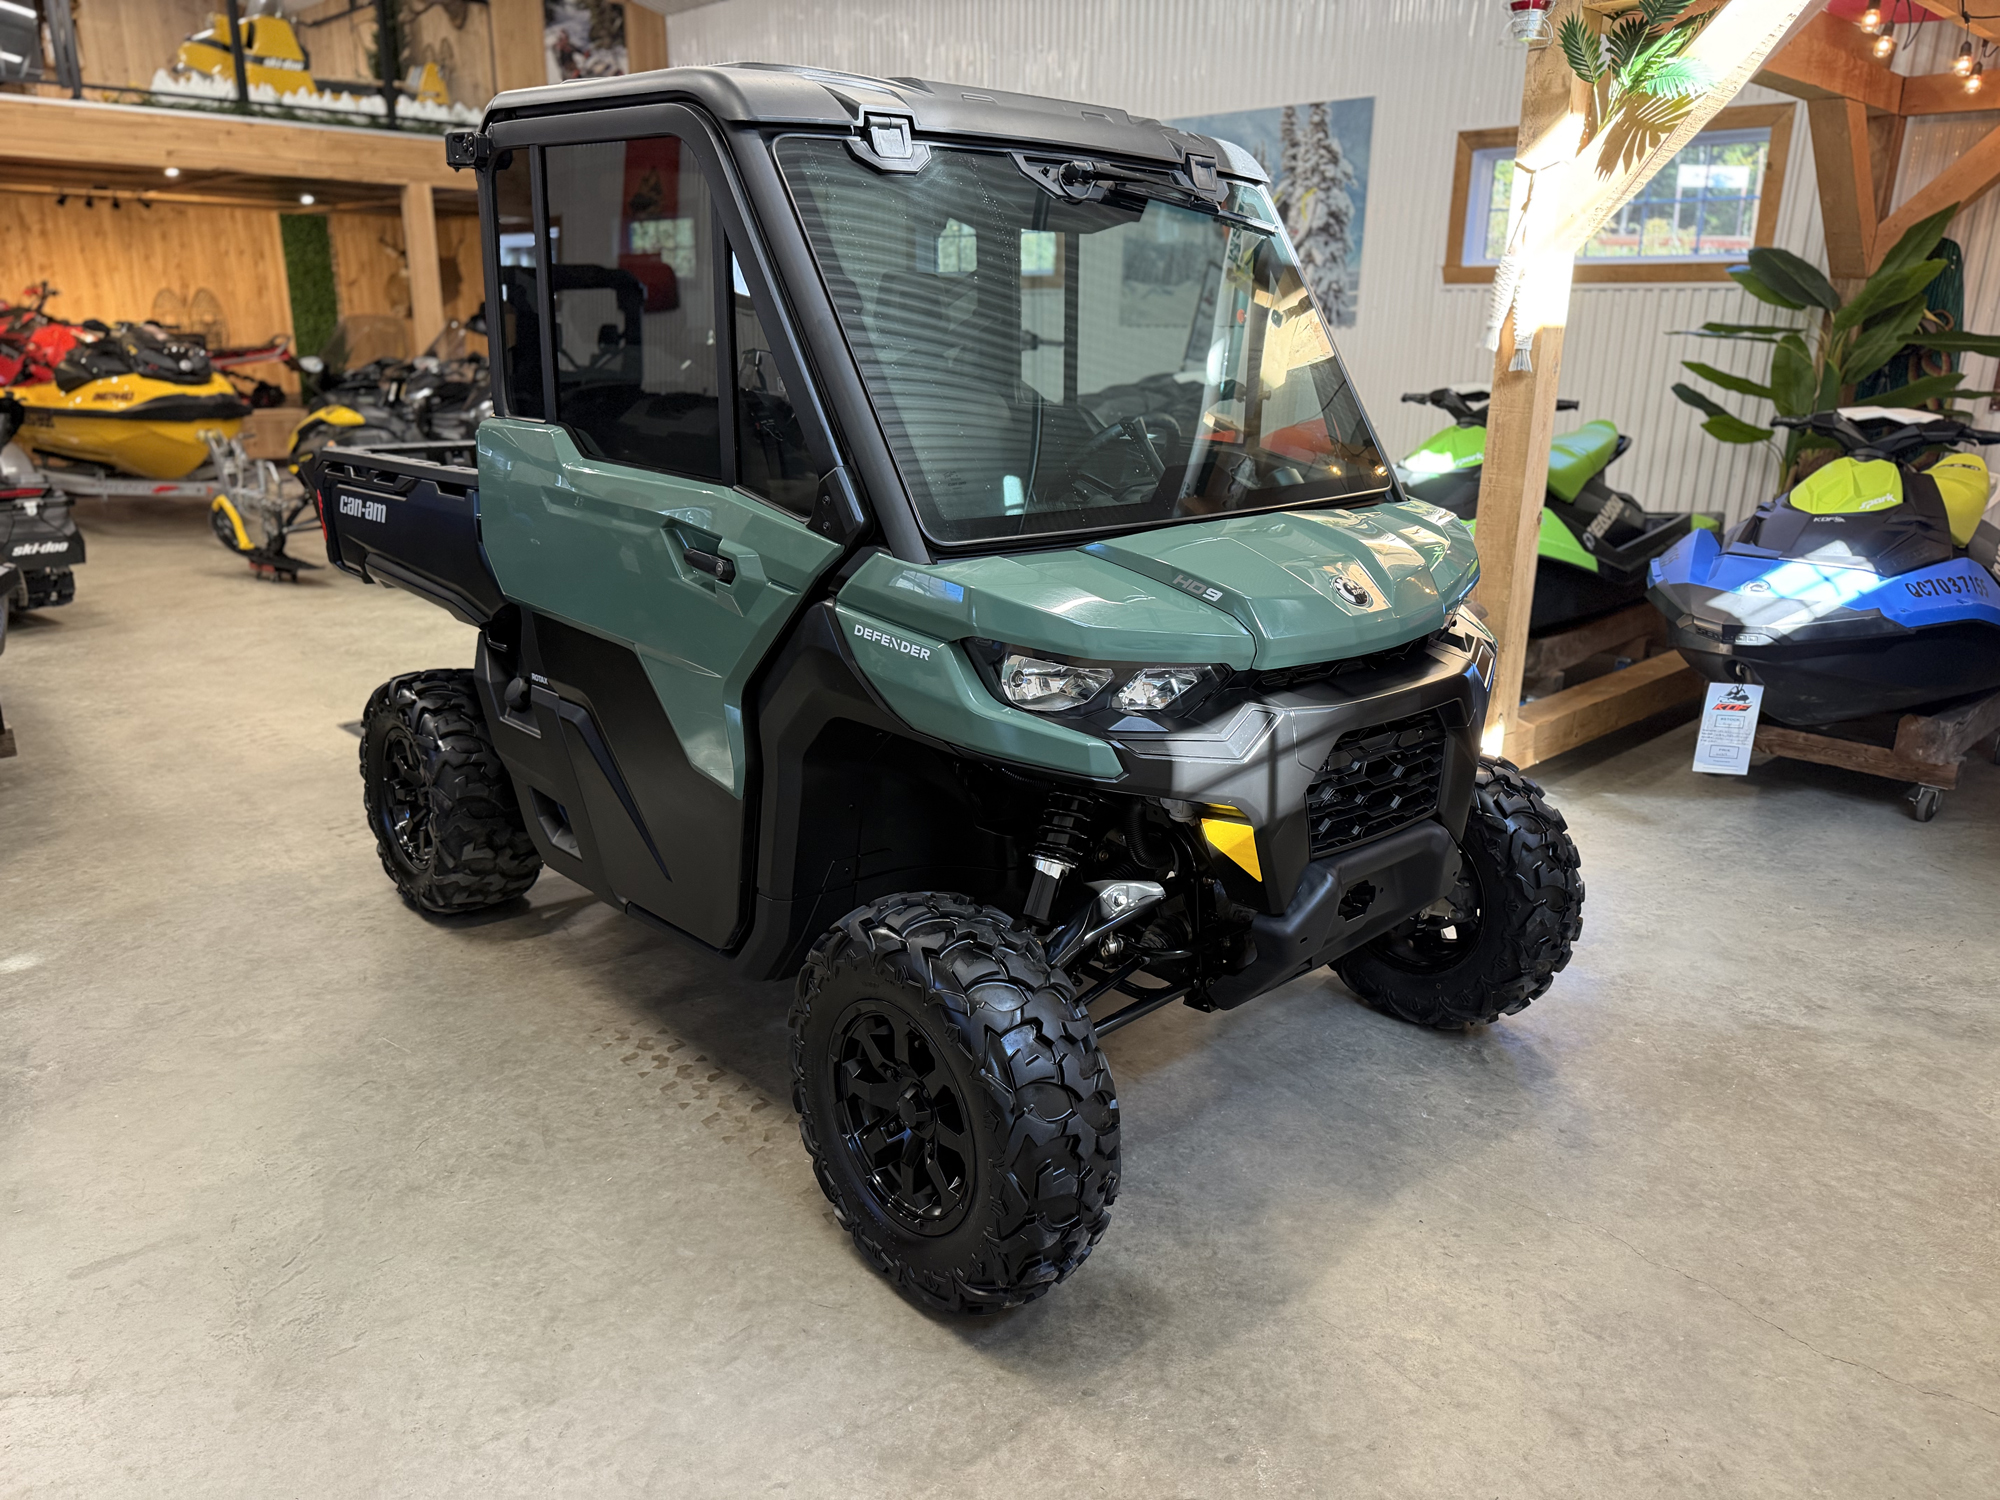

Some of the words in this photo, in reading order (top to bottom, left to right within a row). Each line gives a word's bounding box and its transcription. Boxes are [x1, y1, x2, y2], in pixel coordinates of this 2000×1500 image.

[340, 495, 387, 524] can-am
[1859, 493, 1897, 510] spark
[11, 541, 69, 557] ski-doo
[1172, 574, 1223, 602] HD9
[854, 623, 931, 661] DEFENDER
[531, 672, 549, 685] ROTAX
